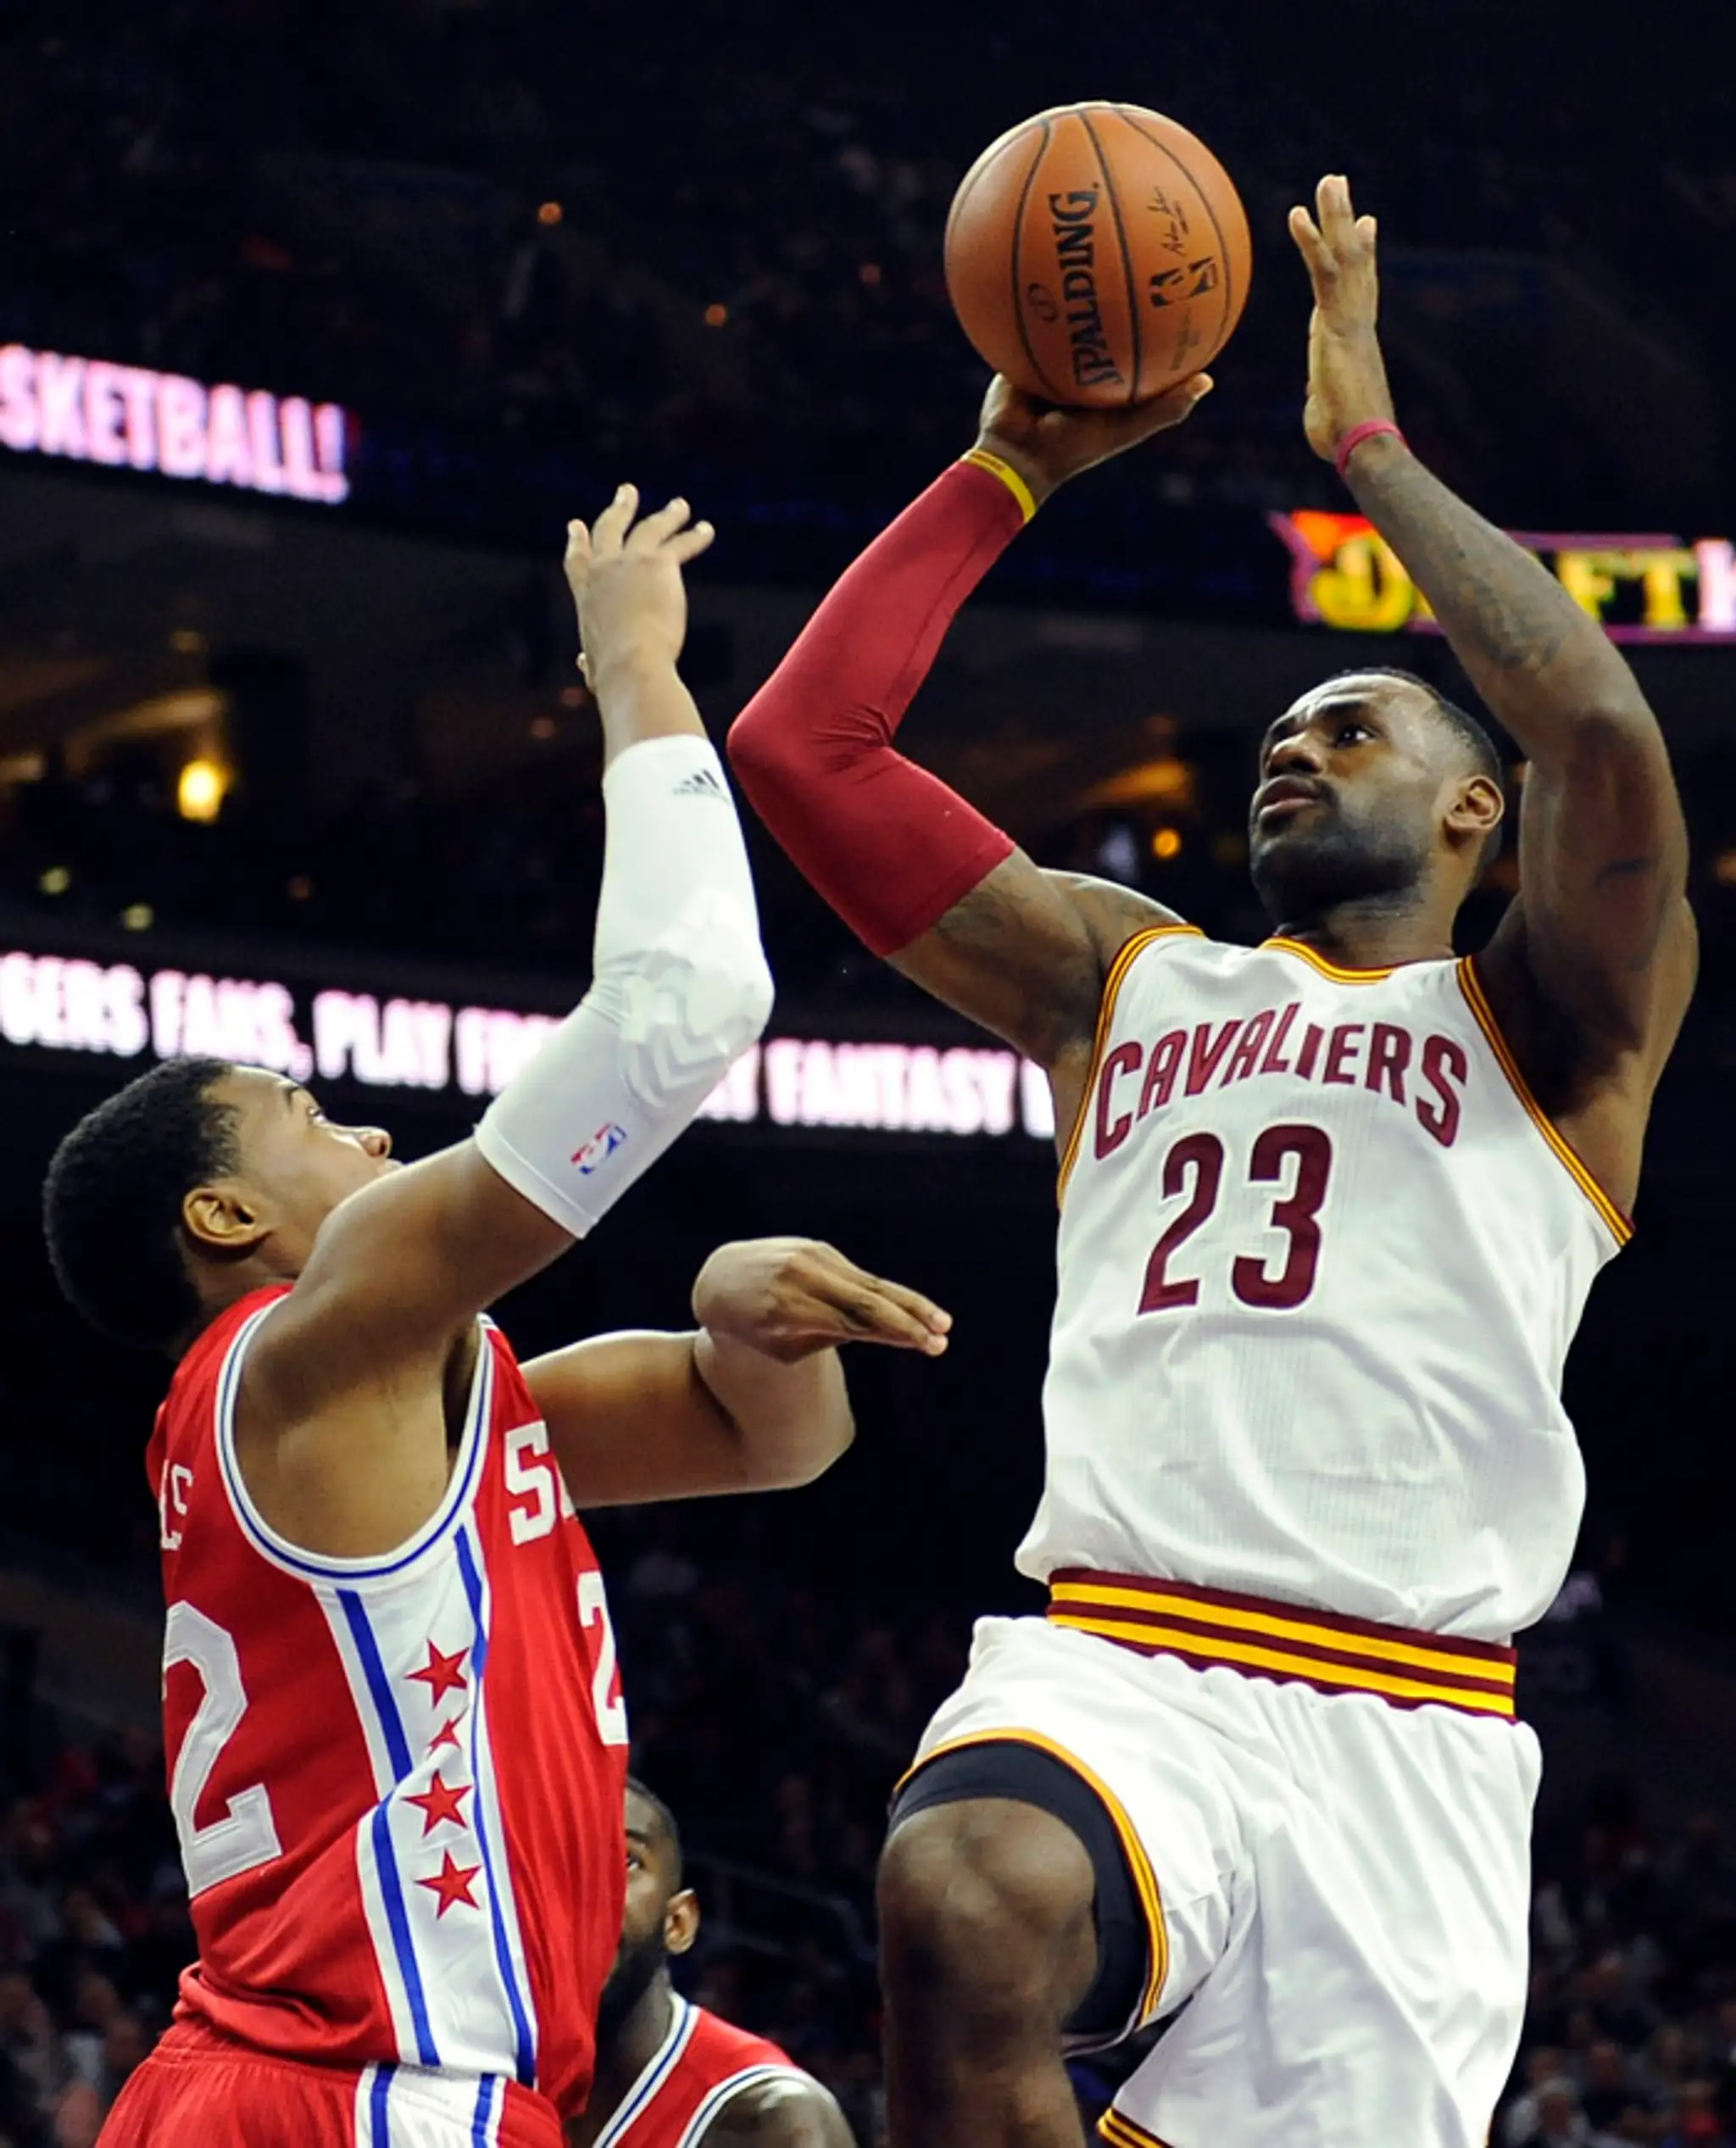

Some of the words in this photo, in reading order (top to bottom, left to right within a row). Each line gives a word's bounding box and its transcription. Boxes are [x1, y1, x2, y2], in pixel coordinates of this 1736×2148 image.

[1049, 189, 1124, 387] SPALDING
[314, 990, 450, 1089] PLAY
[766, 1038, 1015, 1134] FANTASY
[1094, 1002, 1468, 1160] CAVALIERS
[1136, 1122, 1333, 1316] 23
[577, 1570, 630, 1747] 2
